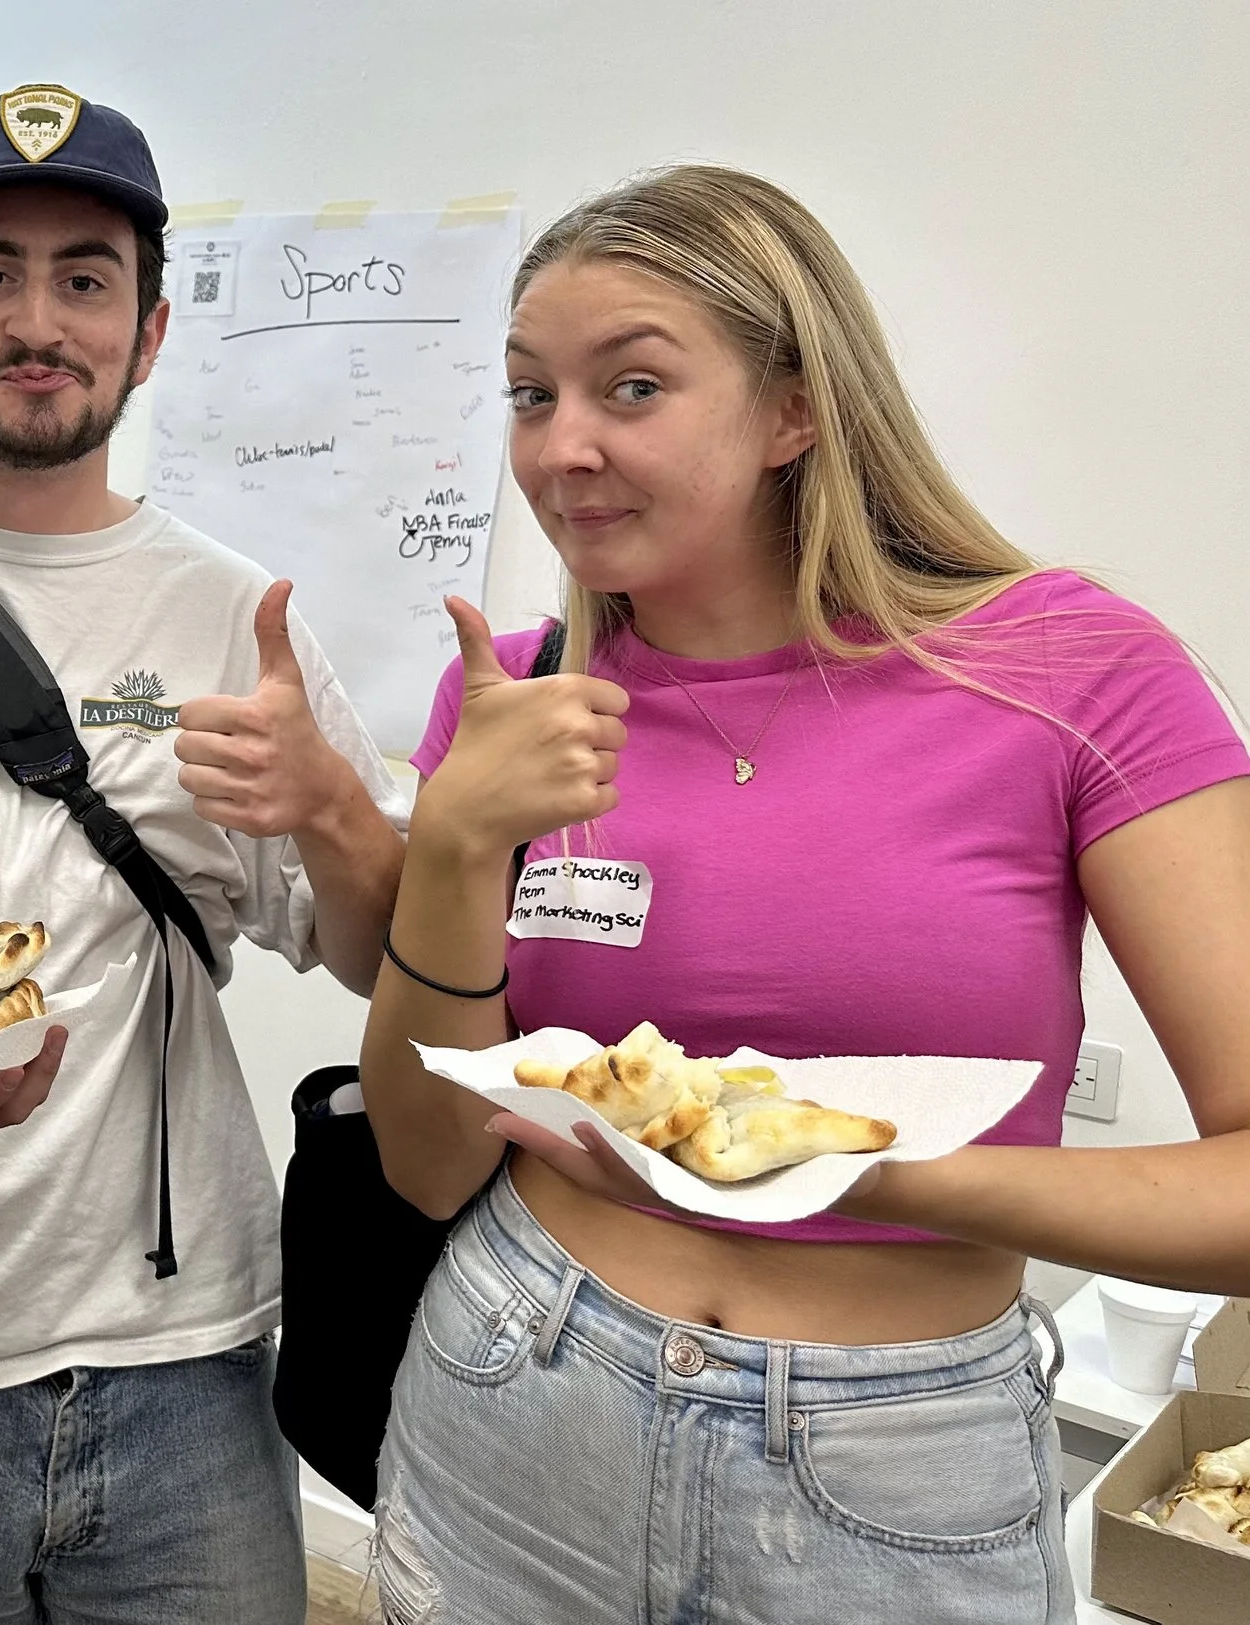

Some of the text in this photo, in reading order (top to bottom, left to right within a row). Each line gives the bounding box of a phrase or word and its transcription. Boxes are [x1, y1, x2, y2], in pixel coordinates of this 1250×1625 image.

[281, 244, 405, 319] Sports
[402, 514, 441, 533] NBA
[523, 867, 557, 881] Emma
[514, 906, 532, 922] The
[615, 913, 644, 927] Sci
